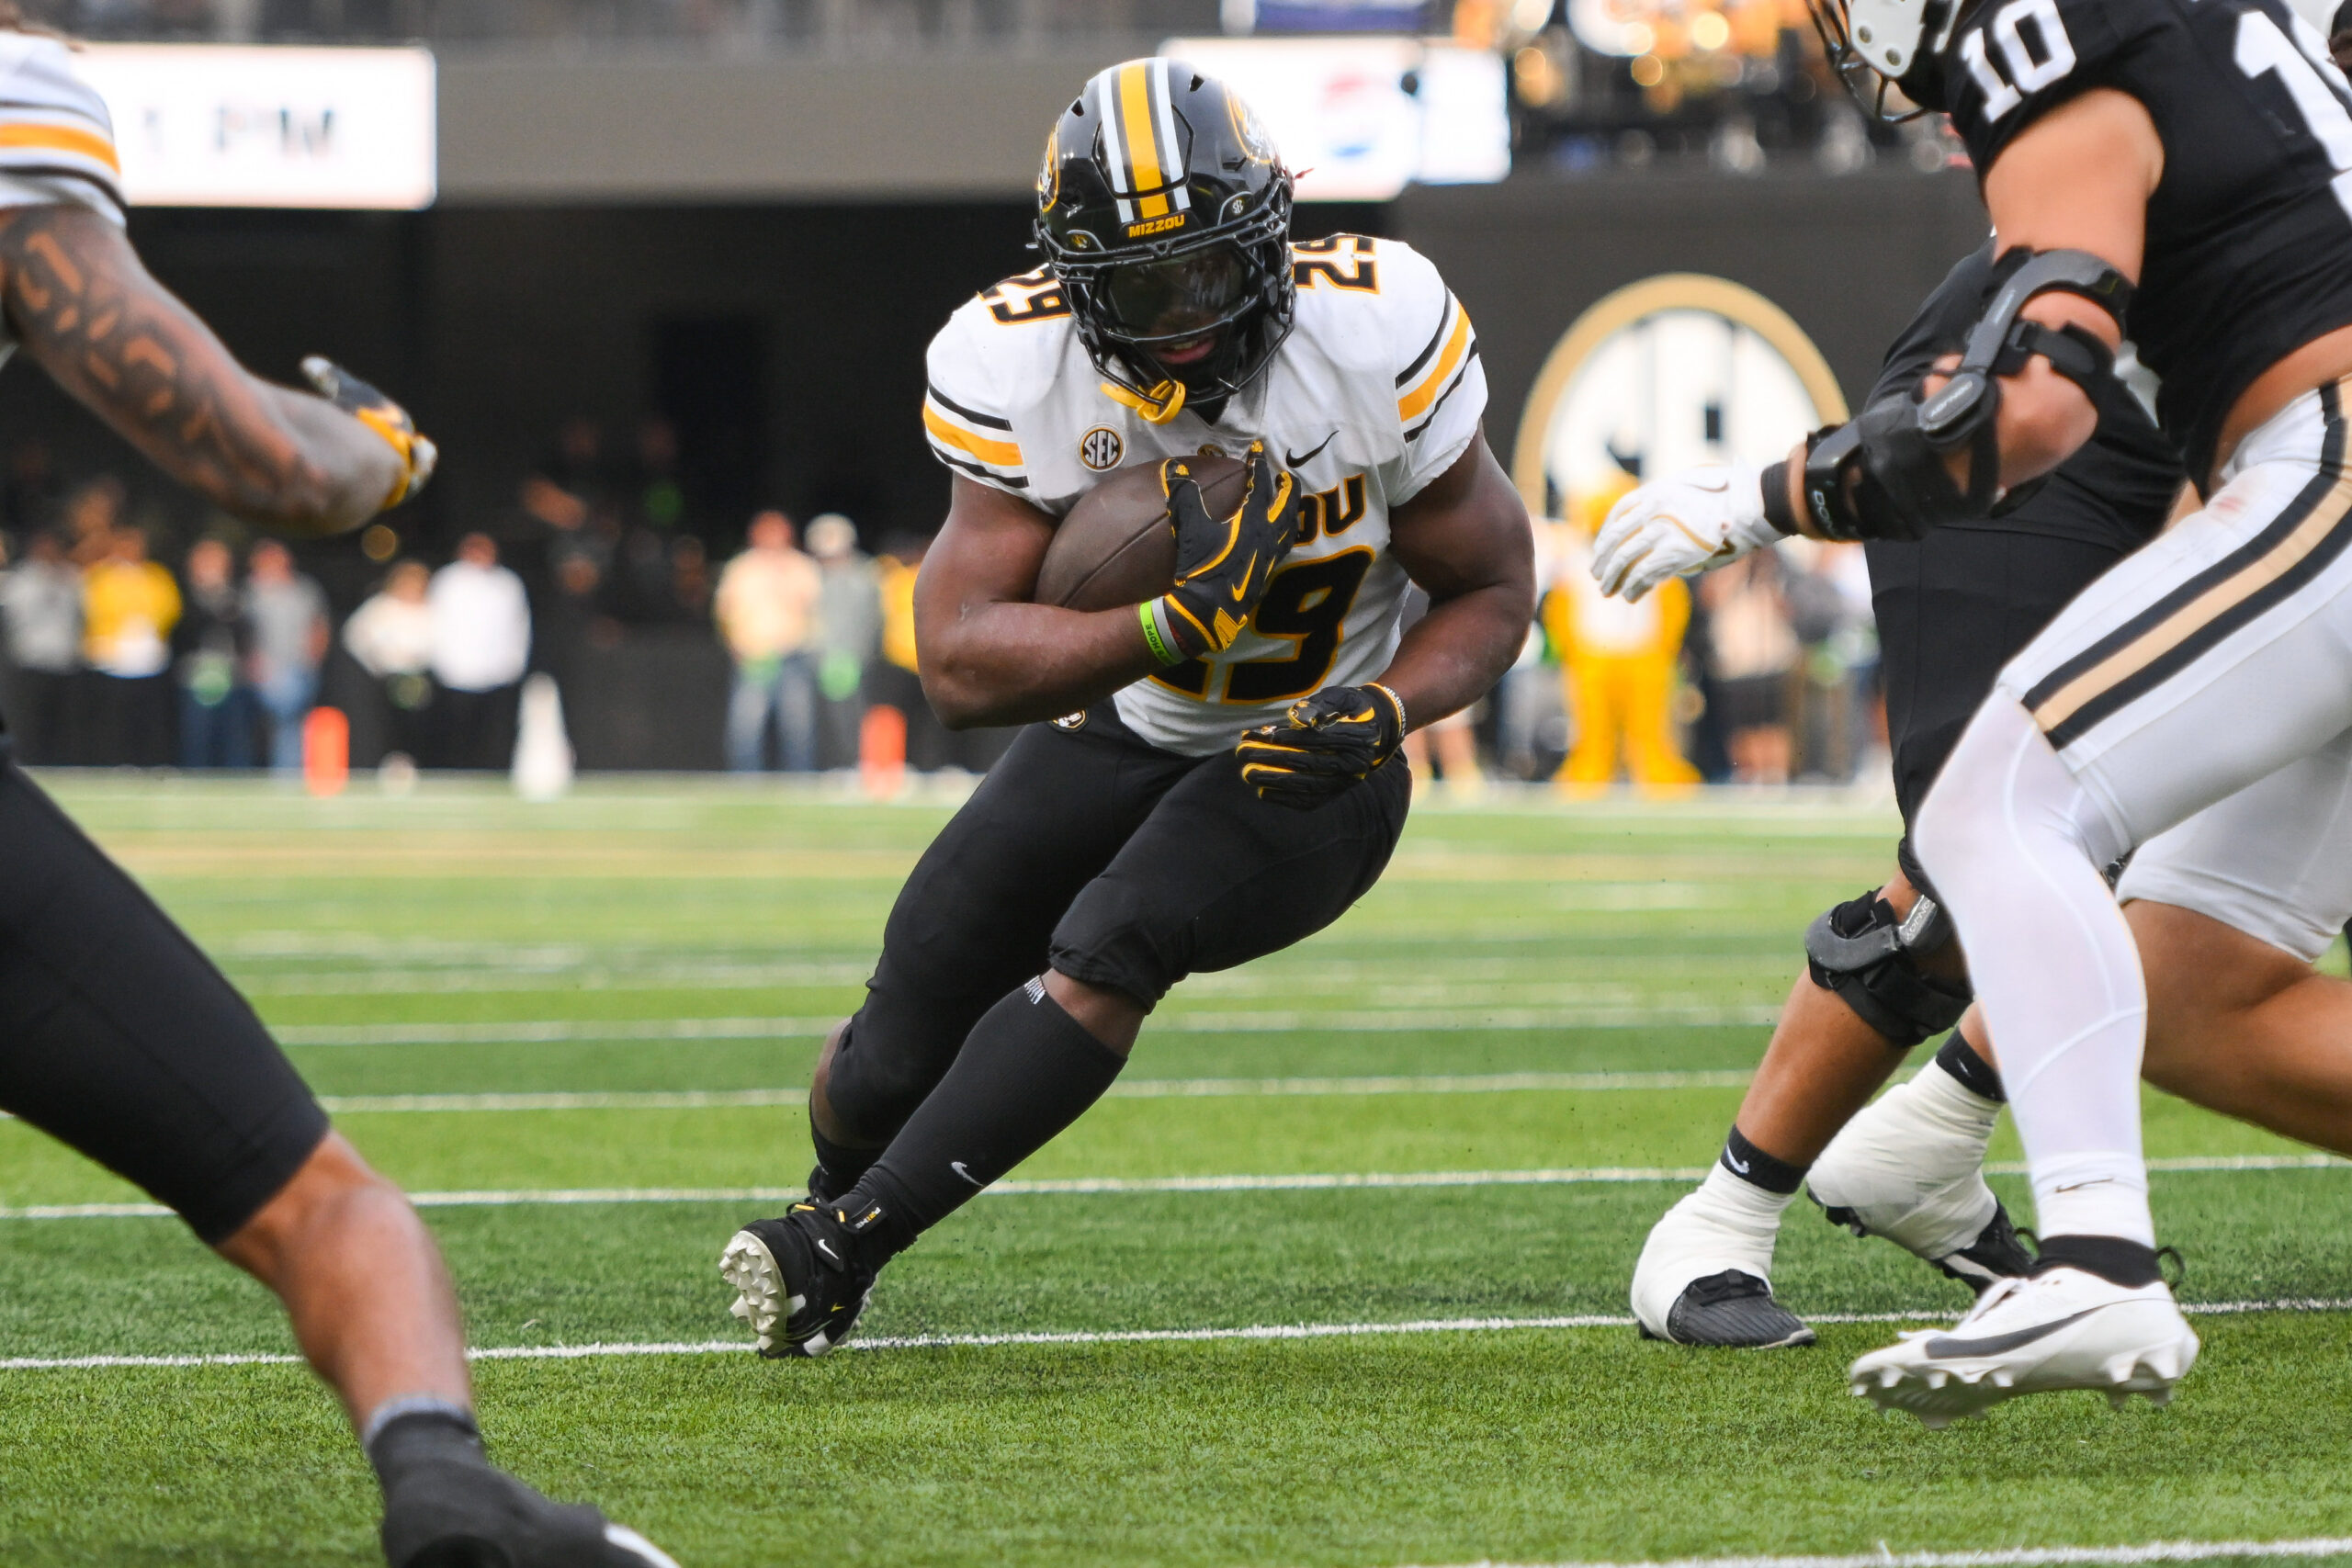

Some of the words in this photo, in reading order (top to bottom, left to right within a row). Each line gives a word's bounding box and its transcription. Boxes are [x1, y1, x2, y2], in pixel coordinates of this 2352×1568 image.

[1961, 0, 2076, 123] 10
[1128, 214, 1185, 238] MIZZOU
[1084, 430, 1119, 467] SEC
[1148, 545, 1375, 705] 9
